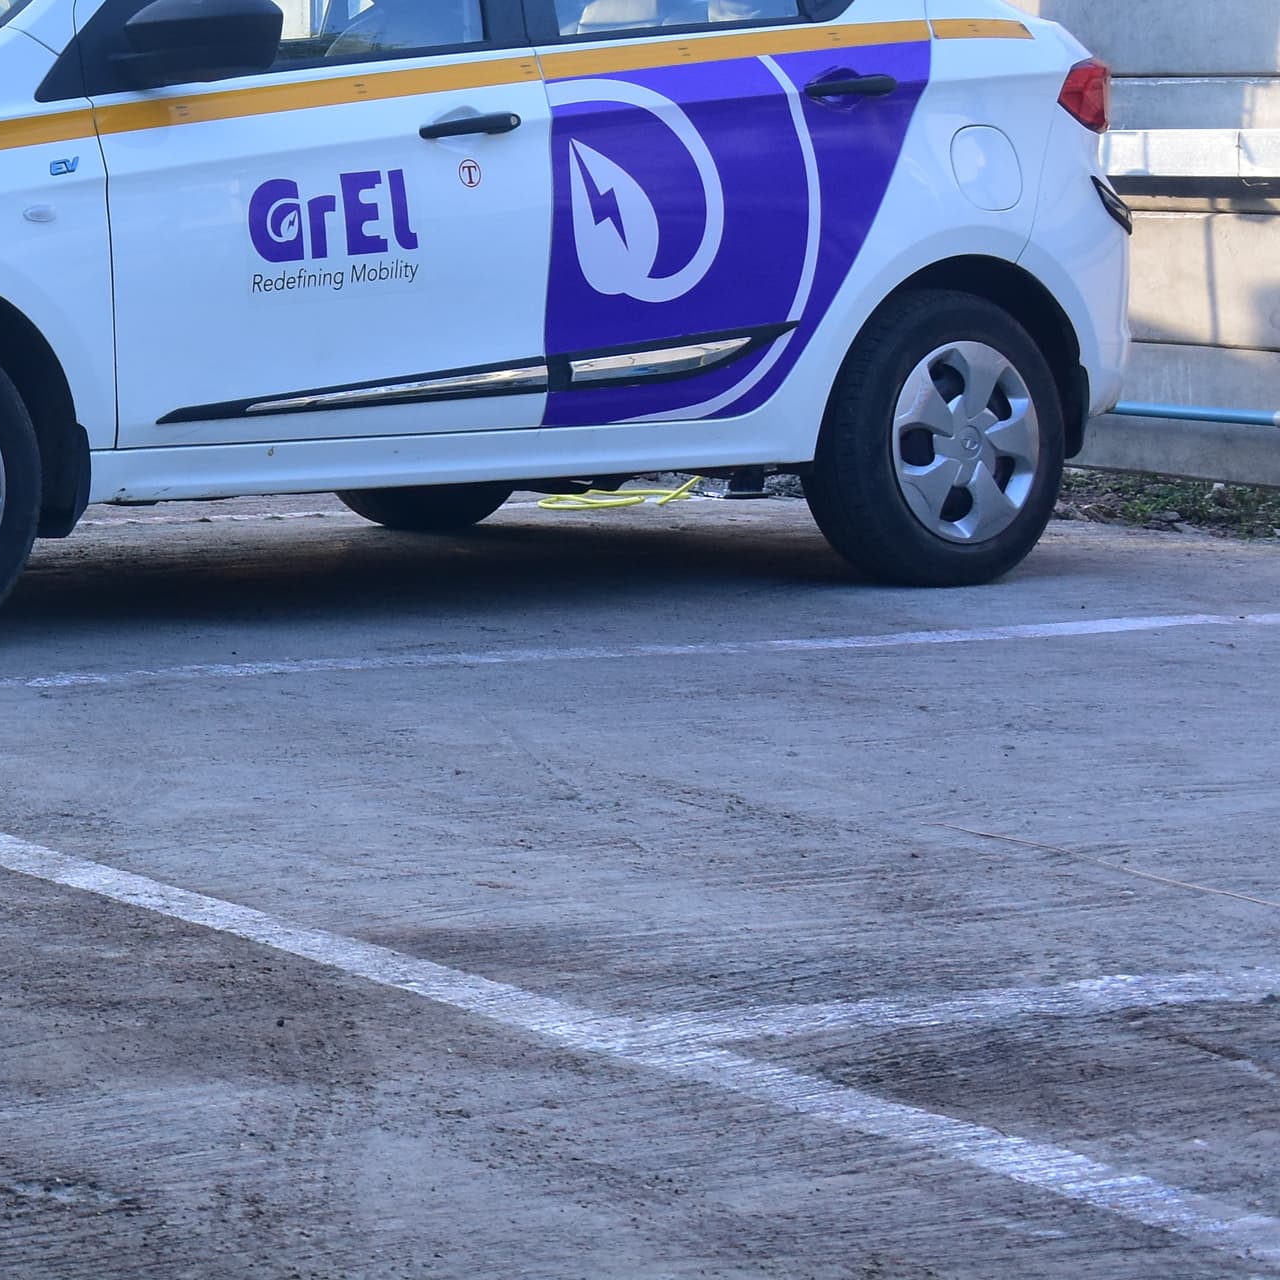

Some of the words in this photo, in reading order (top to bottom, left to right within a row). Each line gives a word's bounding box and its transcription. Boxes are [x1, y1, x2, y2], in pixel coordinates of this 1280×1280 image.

[50, 156, 80, 176] EV
[251, 268, 344, 293] Redefining
[350, 260, 420, 284] Mobility
